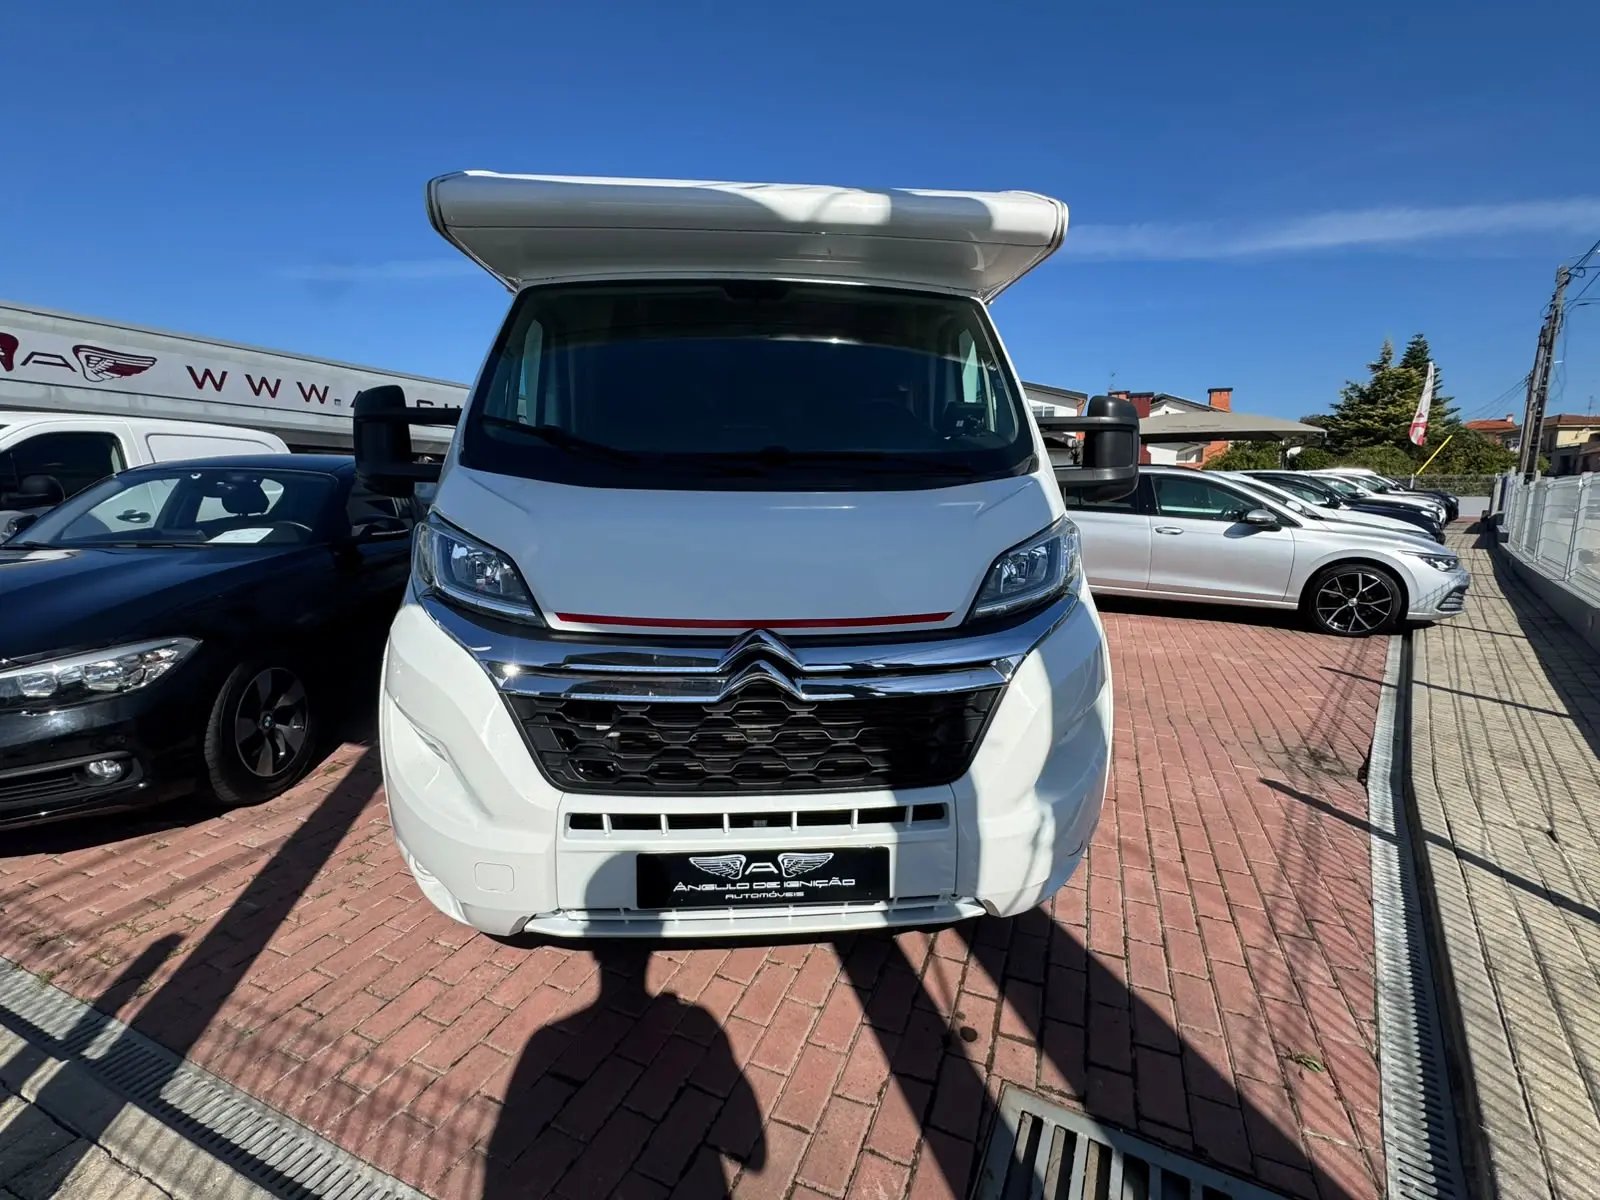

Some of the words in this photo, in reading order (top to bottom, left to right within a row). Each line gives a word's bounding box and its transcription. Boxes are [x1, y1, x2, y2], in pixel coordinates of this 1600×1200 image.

[673, 881, 750, 893] ÂNGULO
[752, 881, 781, 889] DE
[783, 877, 856, 889] IGNIÇÃO
[725, 890, 805, 900] AUTOMÓVEIS
